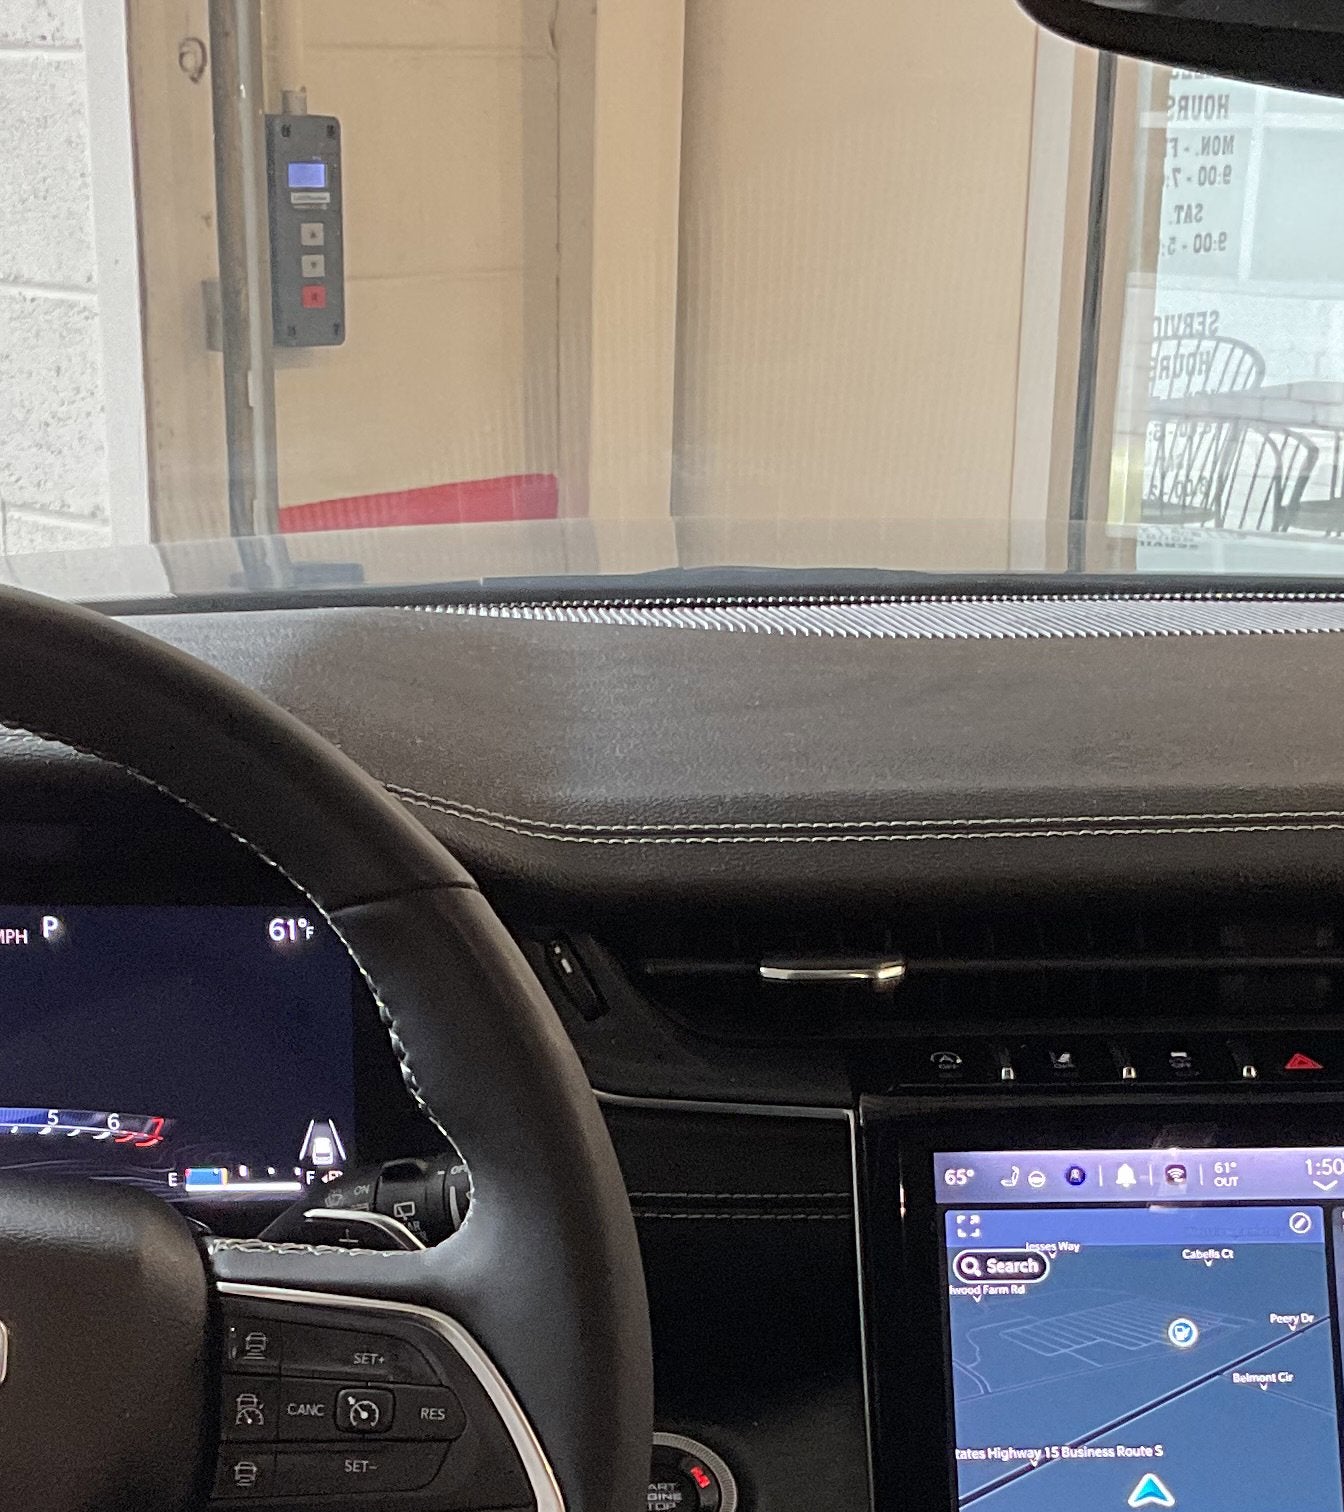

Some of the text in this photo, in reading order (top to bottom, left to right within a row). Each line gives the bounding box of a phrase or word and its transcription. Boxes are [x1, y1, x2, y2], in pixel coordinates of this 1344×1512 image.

[42, 915, 60, 938] P
[48, 1110, 59, 1127] 5
[107, 1113, 120, 1130] 6
[168, 1172, 177, 1187] E
[306, 1170, 315, 1185] F
[1214, 1175, 1238, 1187] OUT
[1058, 1241, 1081, 1253] Way
[1221, 1248, 1234, 1259] Ct
[986, 1257, 1039, 1274] Search
[983, 1284, 1009, 1295] Farm
[1011, 1284, 1026, 1295] Rd
[1300, 1313, 1314, 1323] Dr
[354, 1352, 385, 1365] SET+
[1233, 1372, 1276, 1384] Belmont
[287, 1403, 325, 1417] CANC
[420, 1408, 446, 1421] RES
[987, 1446, 1042, 1463] Highway
[1044, 1446, 1059, 1459] 15
[1061, 1446, 1114, 1459] Business
[1117, 1445, 1153, 1458] Route
[1154, 1445, 1164, 1457] S
[647, 1482, 677, 1491] ART
[647, 1503, 676, 1512] TOP
